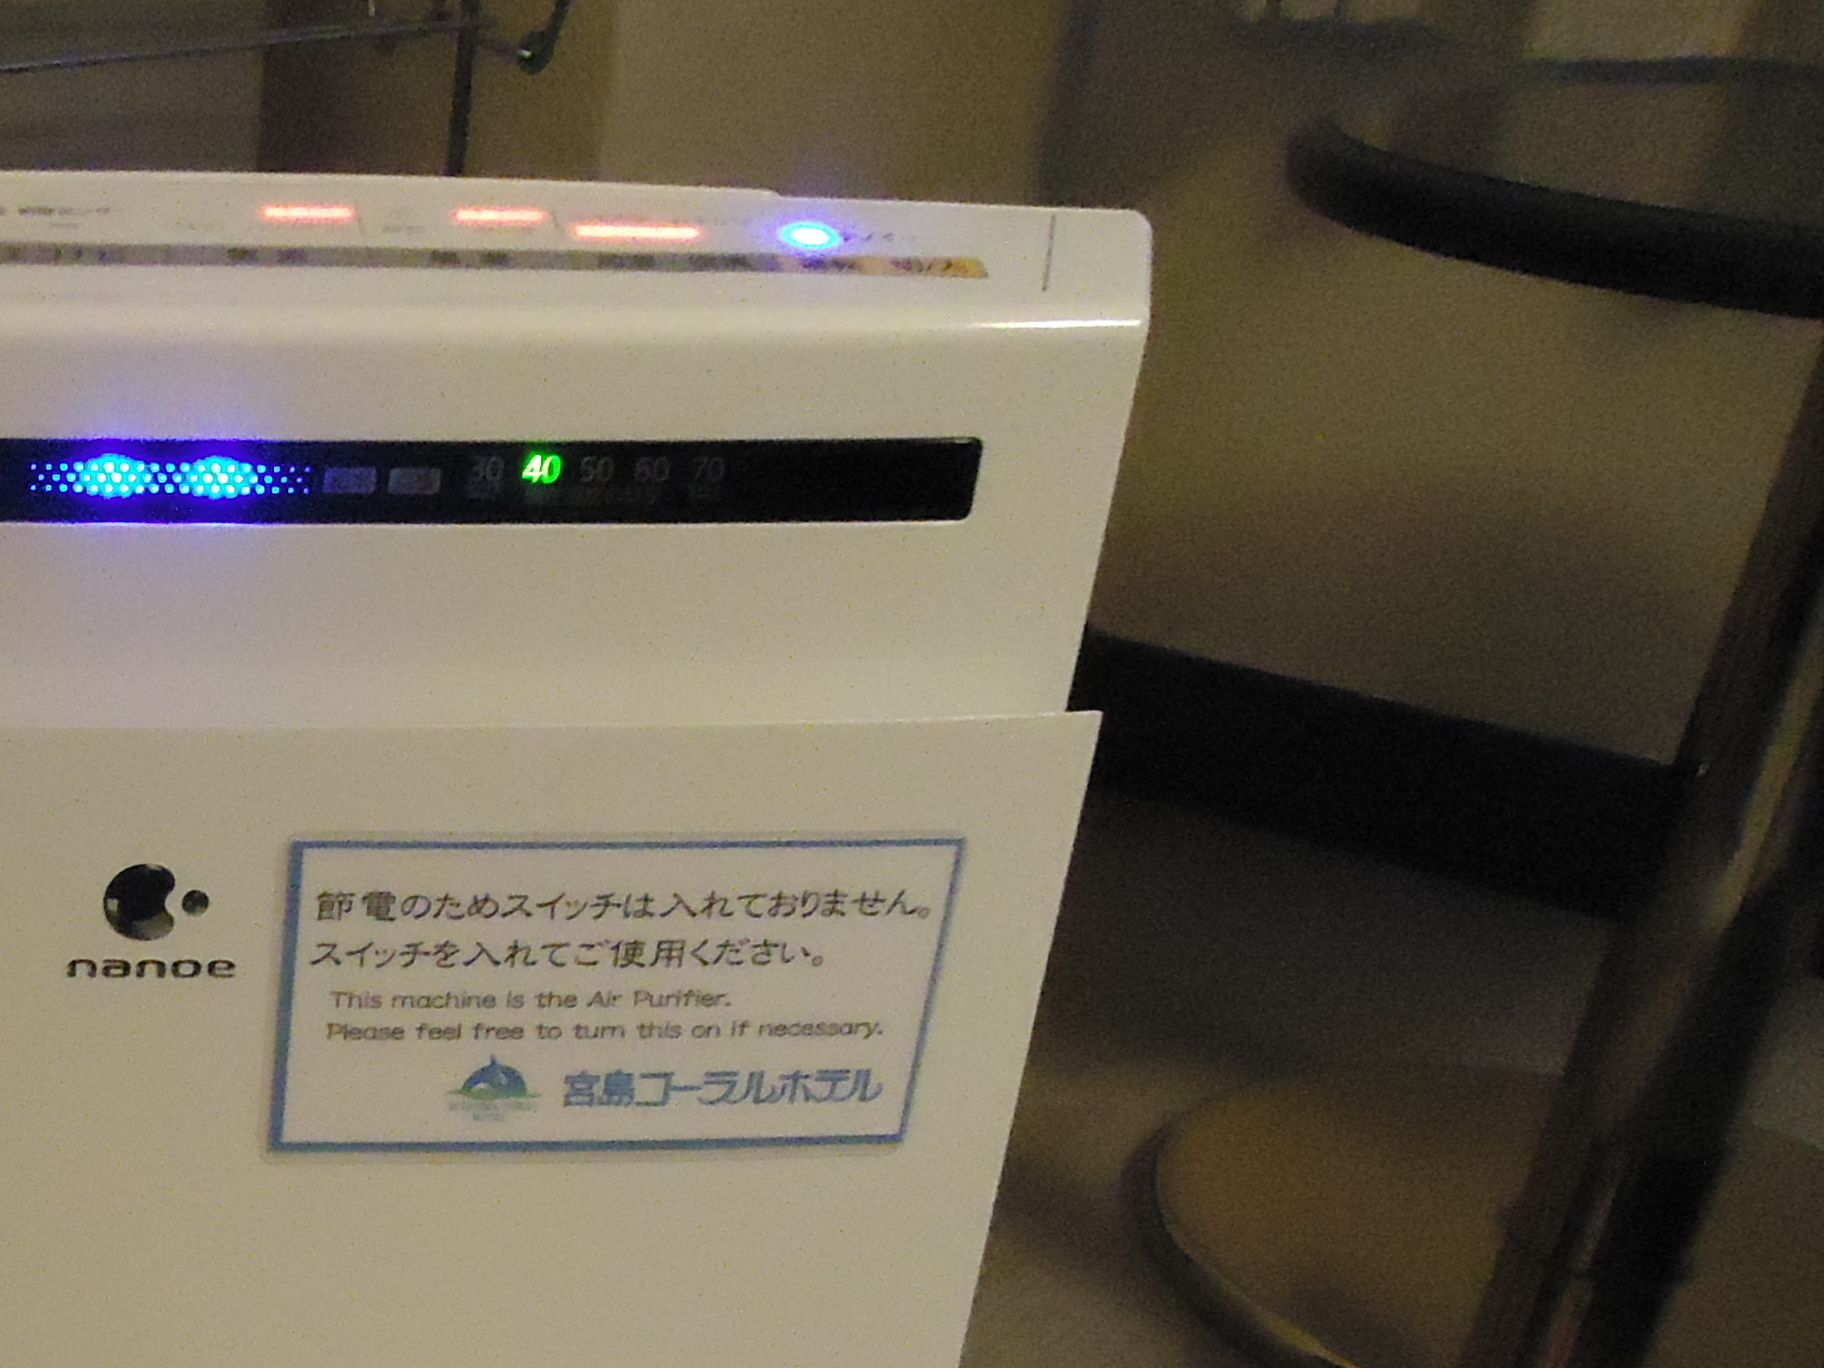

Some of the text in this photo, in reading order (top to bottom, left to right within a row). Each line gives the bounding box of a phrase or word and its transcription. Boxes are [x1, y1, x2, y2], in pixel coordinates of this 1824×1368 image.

[523, 455, 562, 483] 40
[580, 456, 614, 482] 50
[634, 456, 670, 482] 60
[694, 456, 725, 481] 70
[316, 889, 933, 922] 節電のためスイッチは入れておりません。
[309, 938, 825, 970] スイッチを入れてご使用ください。
[67, 958, 236, 979] nanoe
[330, 990, 732, 1009] This machine is the Air Purifier.
[326, 1021, 884, 1041] Please feel free to turn this on if necessary.
[563, 1068, 883, 1106] 宮島コーラルホテル
